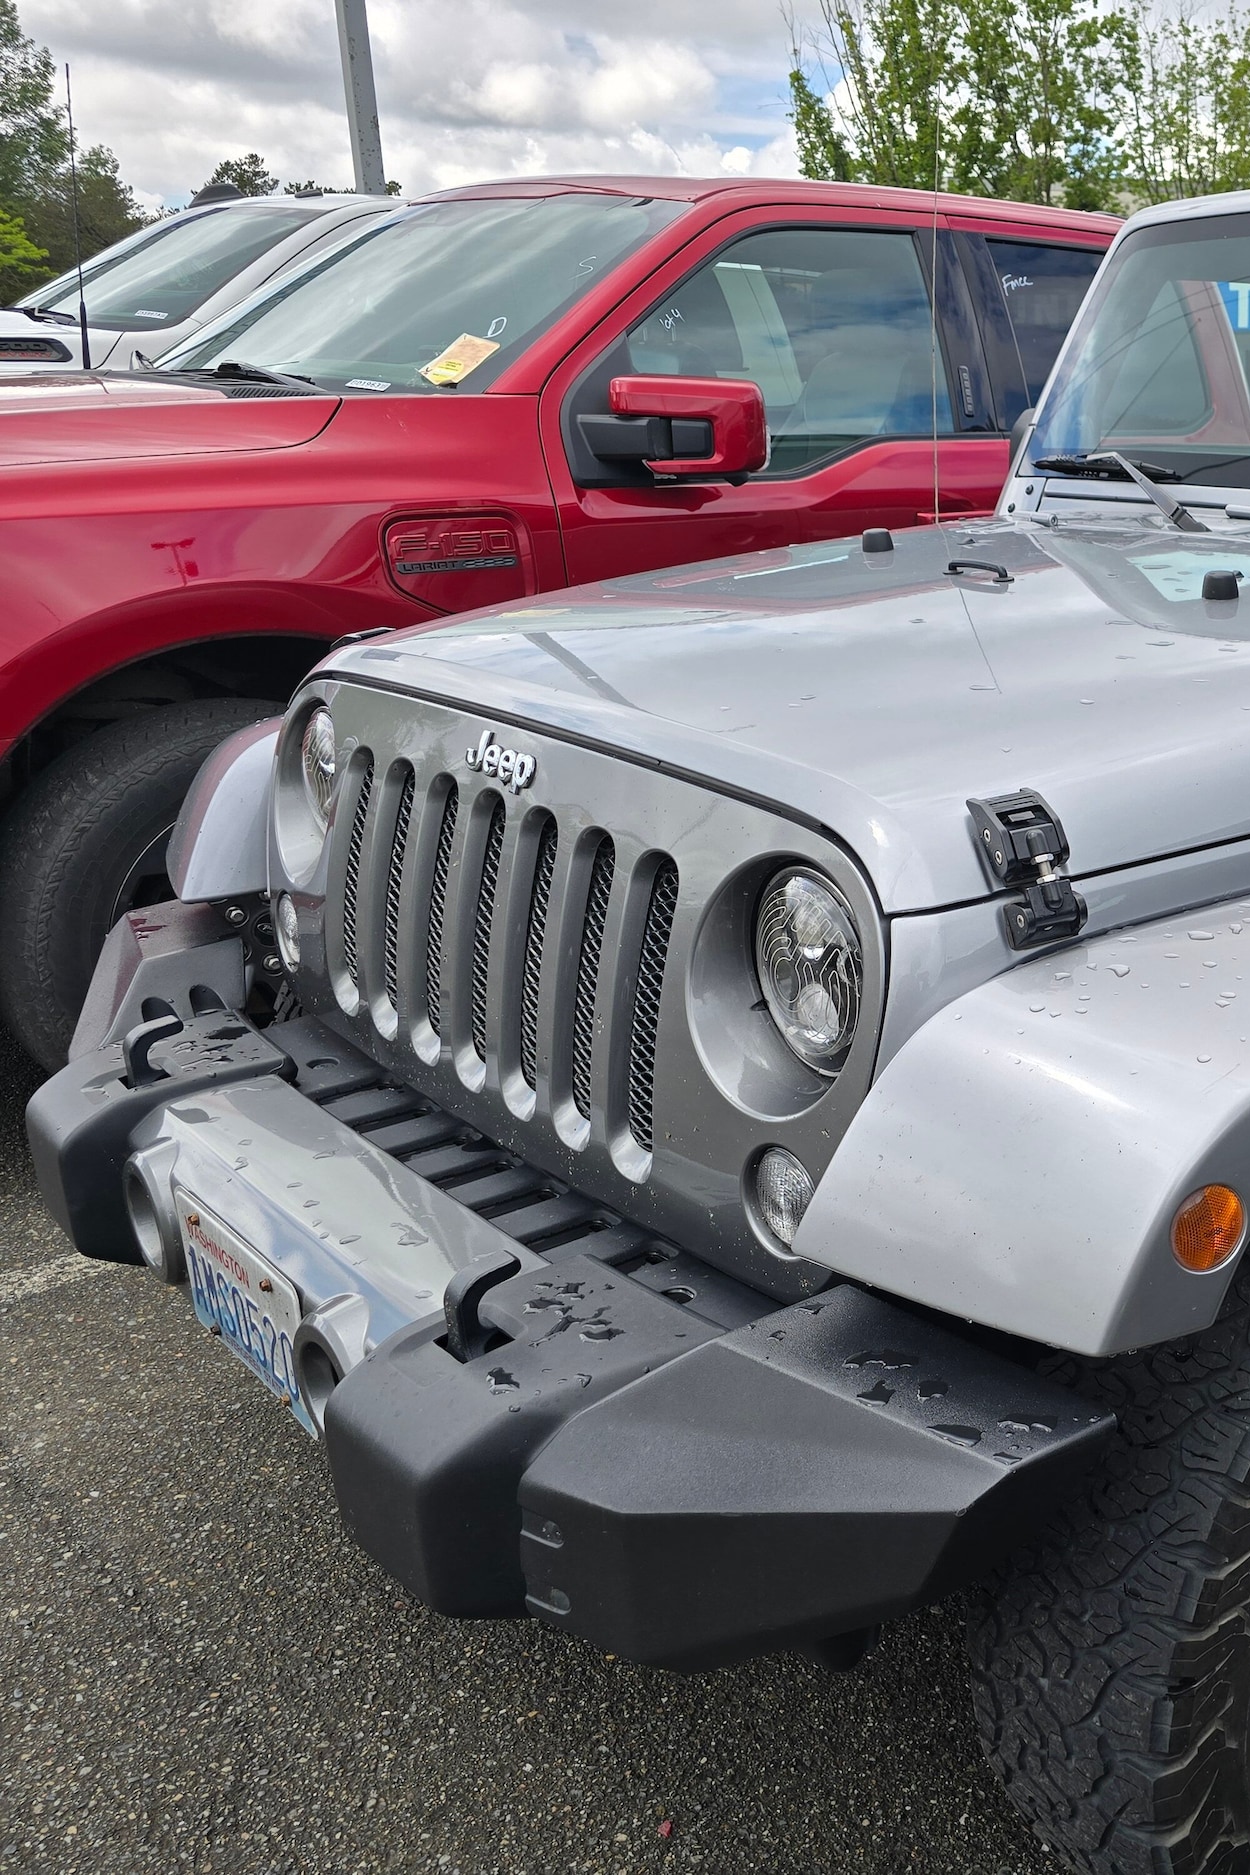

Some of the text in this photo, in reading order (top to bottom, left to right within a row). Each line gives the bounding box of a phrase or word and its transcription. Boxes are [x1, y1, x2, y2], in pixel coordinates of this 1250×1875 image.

[390, 530, 516, 560] F-150
[402, 560, 460, 573] LARIAT
[466, 730, 536, 795] Jeep
[184, 1215, 250, 1289] WASHINGTON
[188, 1244, 300, 1402] AMS0520
